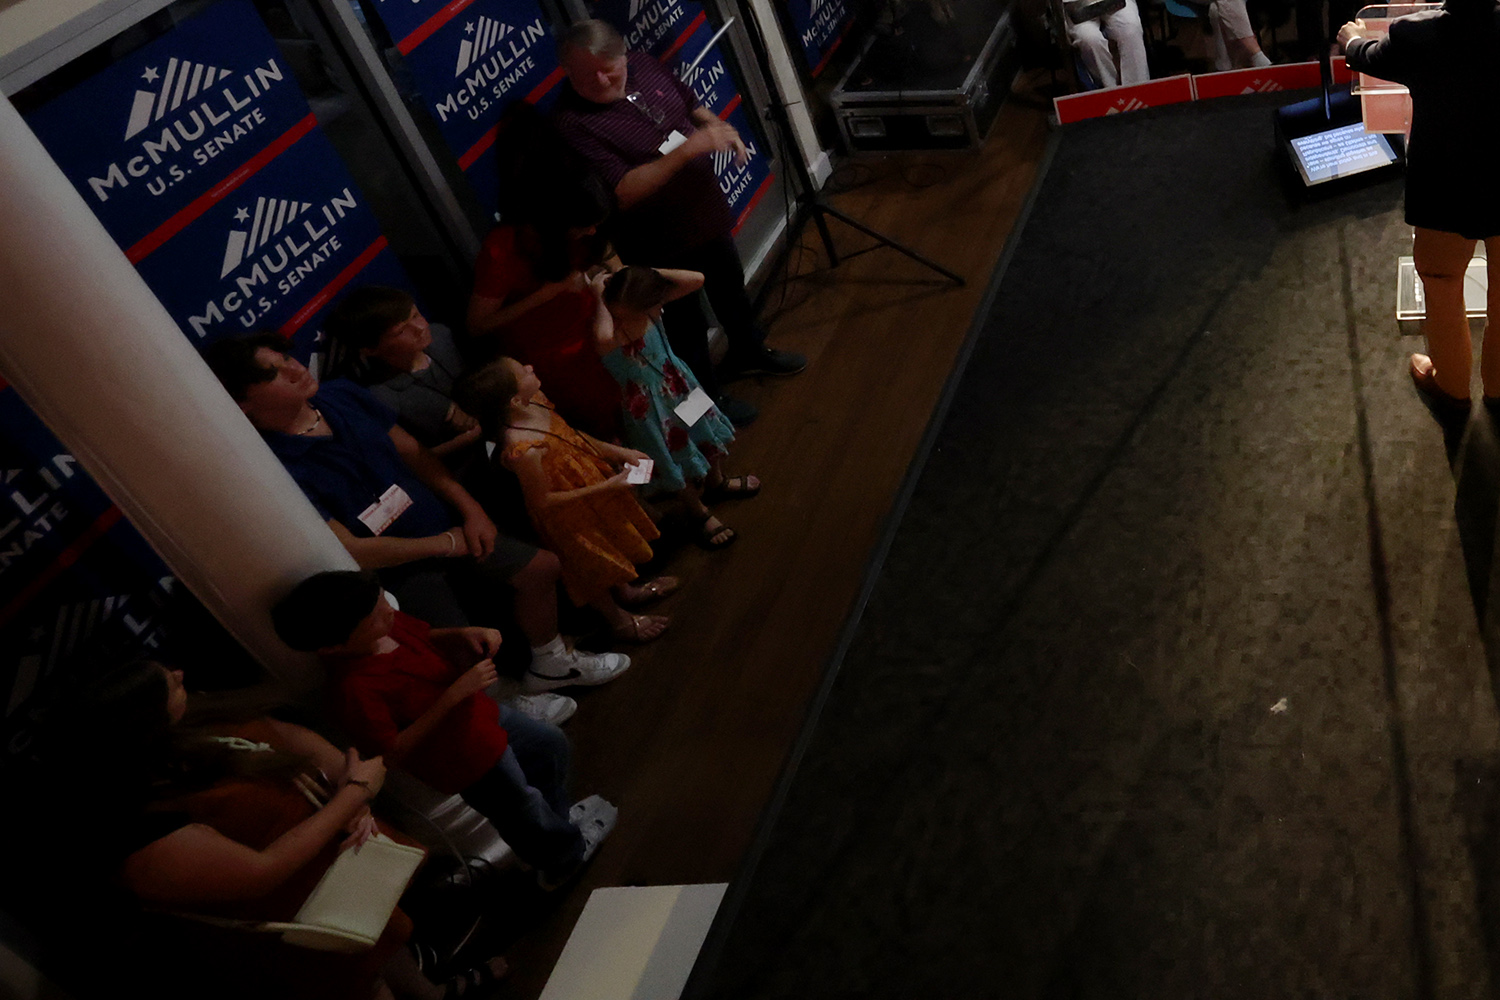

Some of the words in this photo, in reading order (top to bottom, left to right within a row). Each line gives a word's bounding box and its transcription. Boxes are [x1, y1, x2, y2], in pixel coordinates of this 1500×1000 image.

[436, 18, 546, 122] McMULLIN
[467, 95, 494, 121] U.S.
[493, 56, 536, 99] SENATE
[87, 58, 283, 203] McMULLIN
[146, 165, 192, 197] U.S.
[194, 107, 266, 168] SENATE
[188, 187, 358, 337] McMULLIN
[239, 296, 278, 328] U.S.
[278, 235, 342, 295] SENATE
